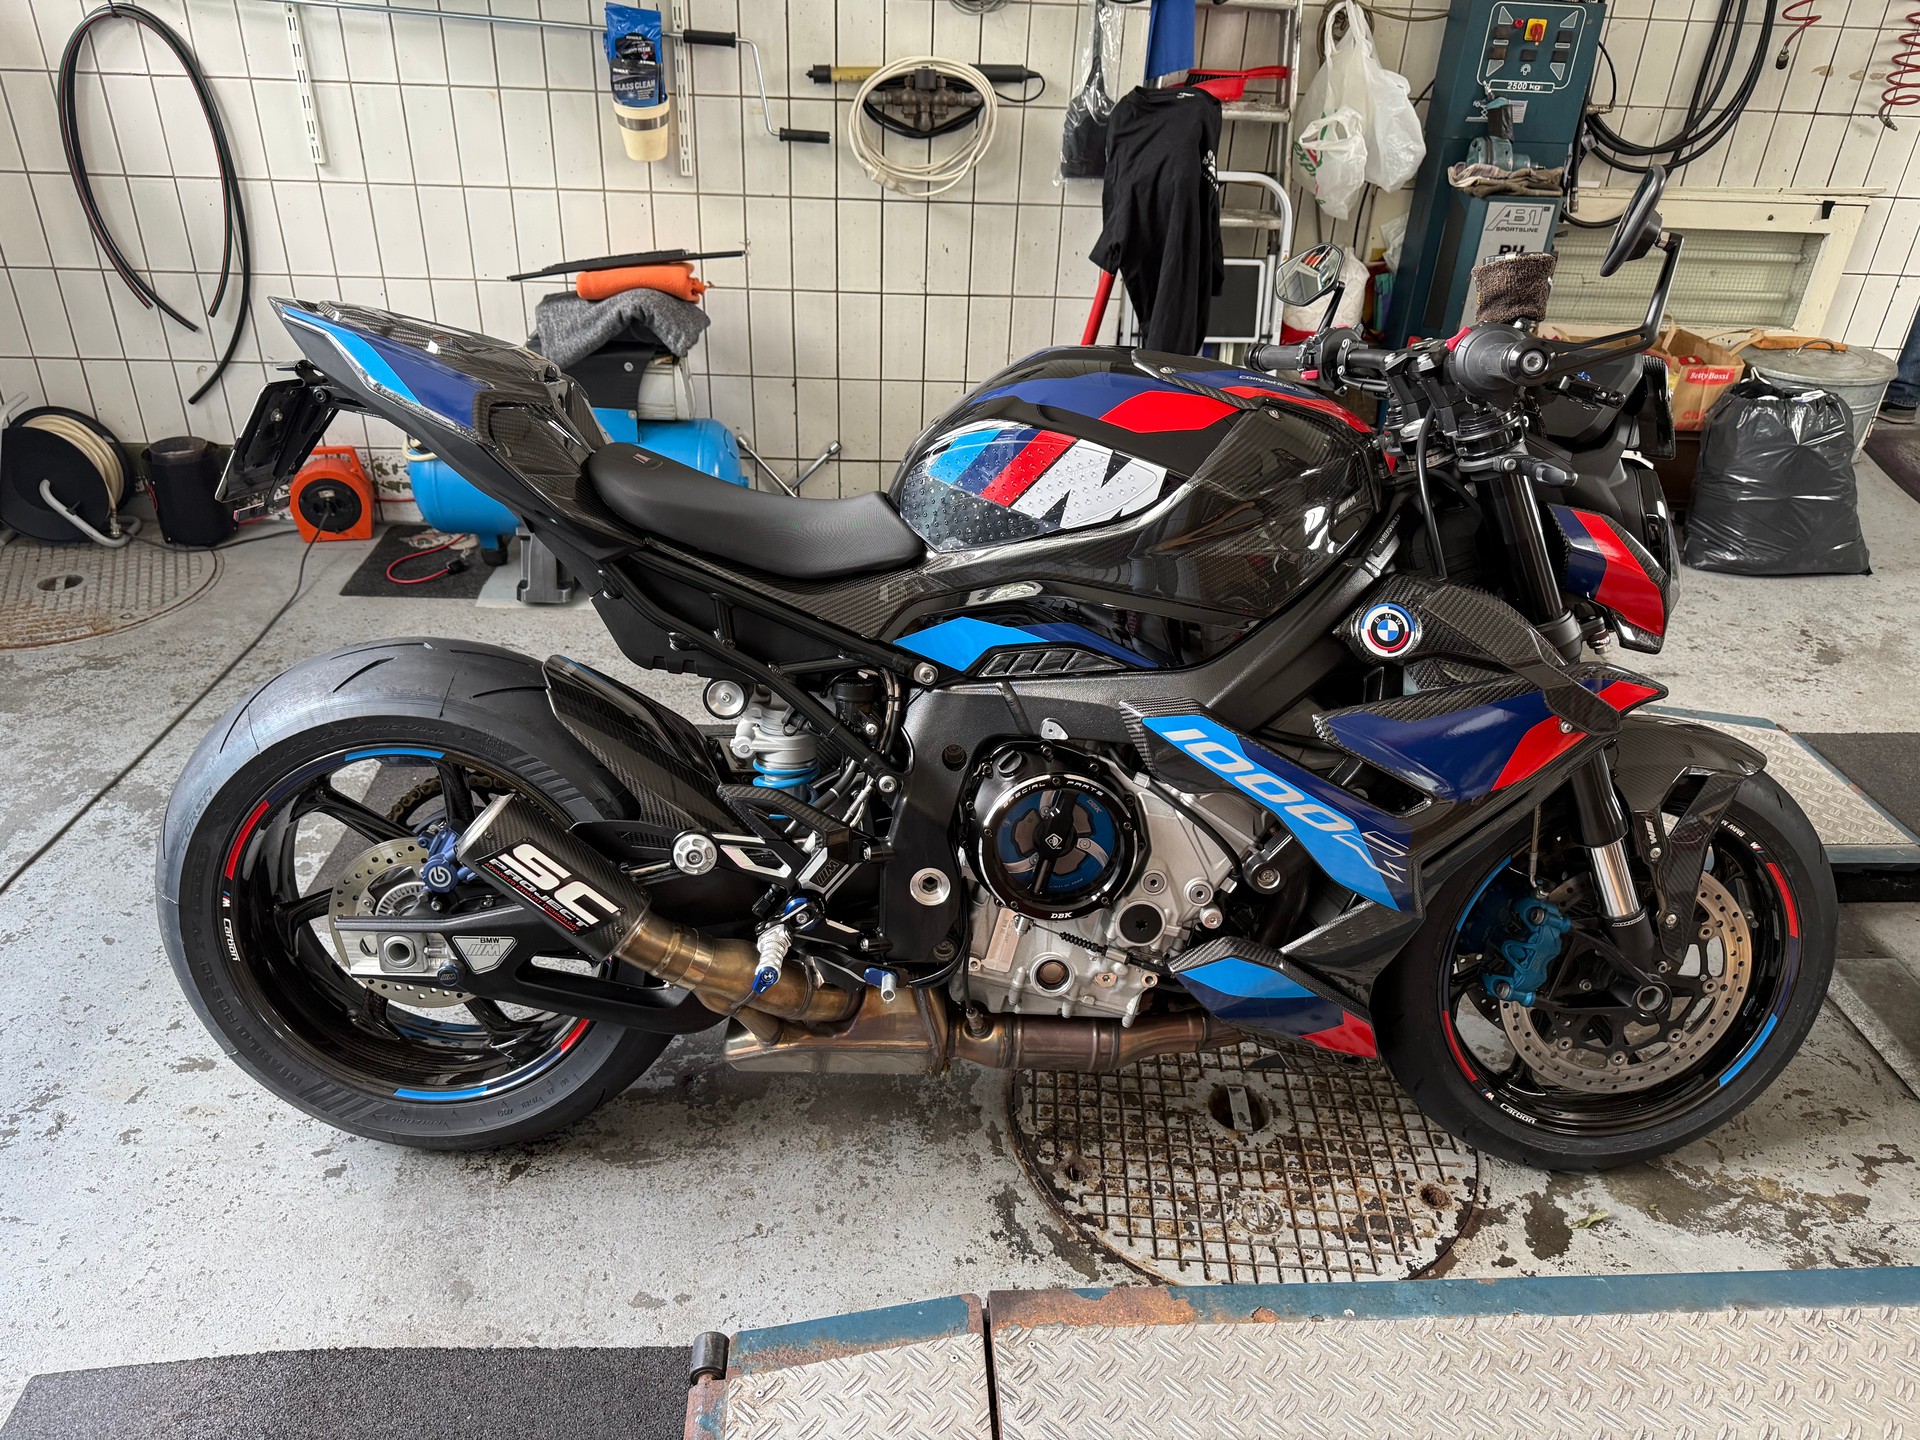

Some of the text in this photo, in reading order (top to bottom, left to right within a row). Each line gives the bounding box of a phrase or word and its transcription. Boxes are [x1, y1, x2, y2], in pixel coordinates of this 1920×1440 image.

[614, 79, 656, 91] GLASS CLEAN
[1507, 82, 1527, 90] 2500
[1485, 205, 1543, 231] ABT
[1239, 375, 1299, 391] competition
[1690, 372, 1730, 382] Betty Bossi
[1374, 613, 1403, 625] BMW
[1162, 728, 1355, 832] 1000
[1002, 780, 1104, 809] SPECIAL PARTS
[1086, 799, 1103, 813] DBK
[1728, 824, 1745, 838] BMW
[488, 858, 590, 928] PROJECT
[497, 843, 620, 926] SC
[484, 862, 581, 931] ADVANCED EXHAUST TECHNOLOGY
[1050, 911, 1073, 919] DBK
[224, 918, 241, 961] Carbon
[1500, 1103, 1537, 1125] Carbon
